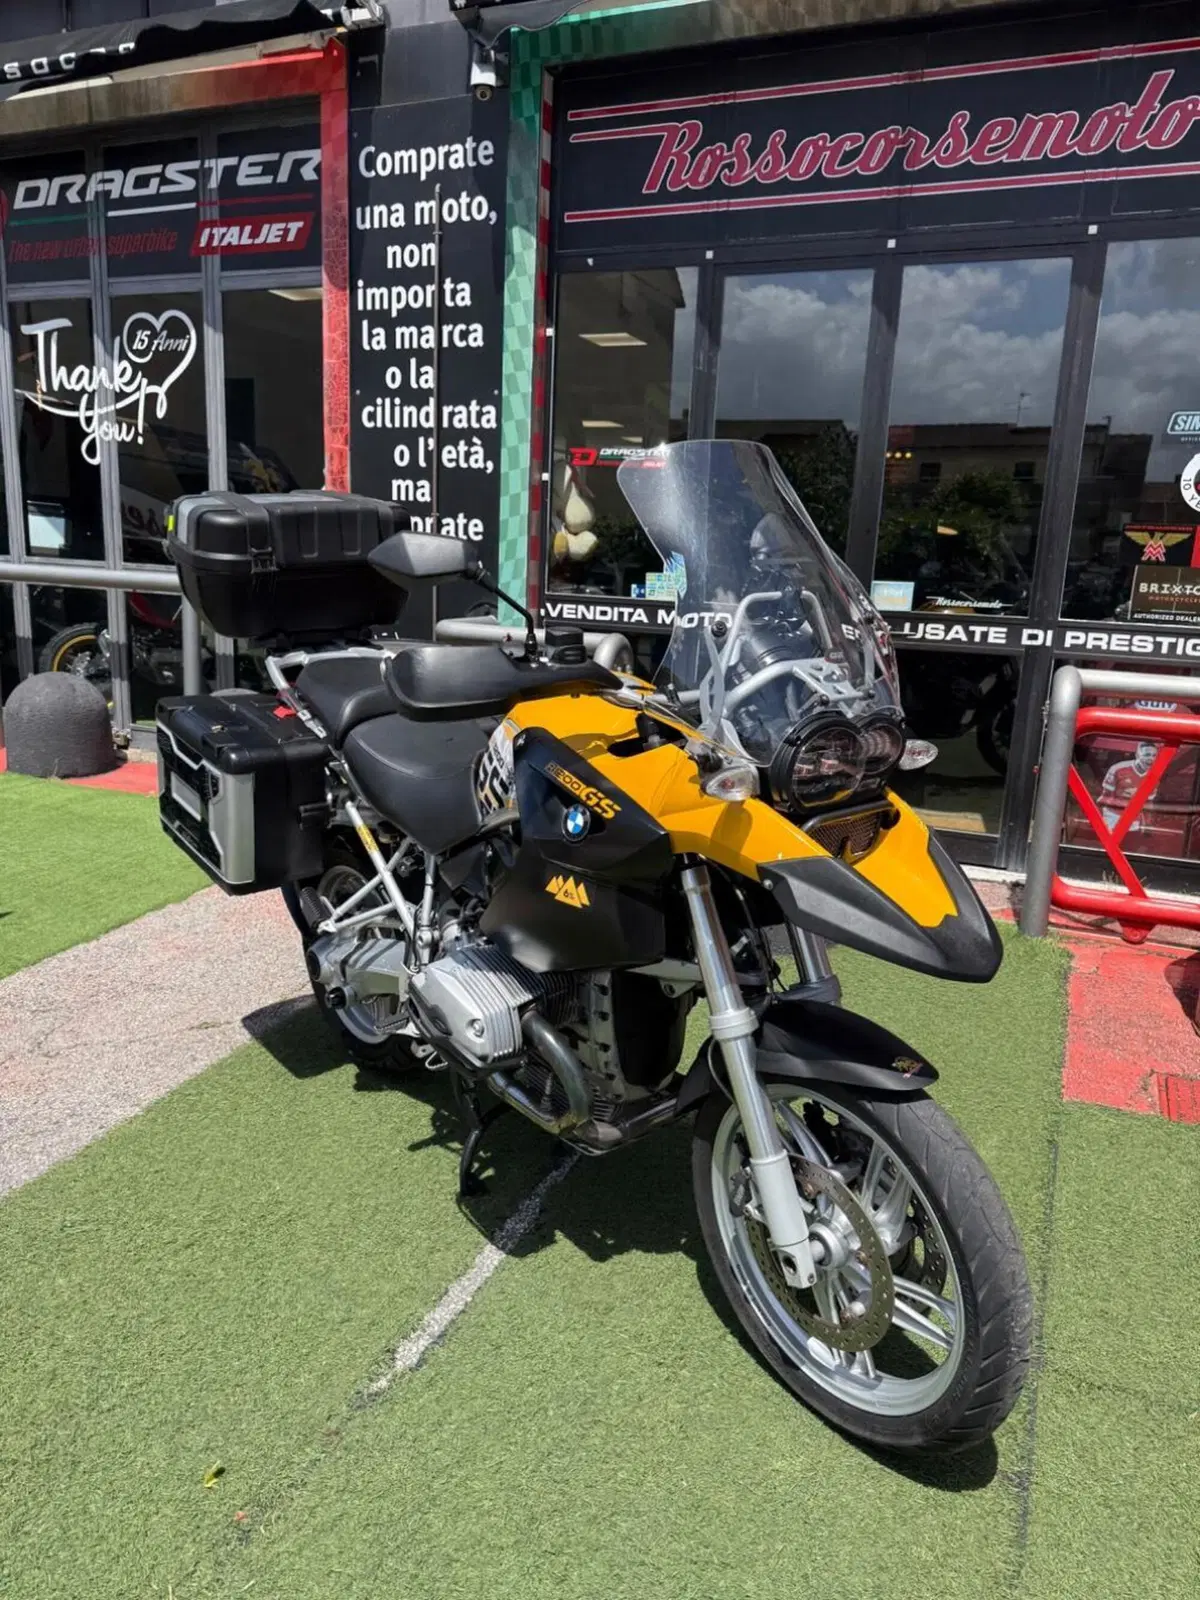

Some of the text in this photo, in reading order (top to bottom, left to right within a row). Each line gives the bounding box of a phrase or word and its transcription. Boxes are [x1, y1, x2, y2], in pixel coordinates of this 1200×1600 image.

[642, 68, 1200, 195] Rossocorsemoto
[358, 136, 495, 182] Comprate
[13, 149, 321, 210] DRAGSTER
[356, 190, 498, 230] una moto,
[199, 220, 305, 248] ITALJET
[386, 242, 437, 269] non
[357, 276, 472, 318] importa
[132, 329, 190, 353] 15 Anni
[361, 319, 485, 351] la marca
[21, 318, 143, 393] Thank
[385, 357, 436, 390] o la
[361, 397, 498, 430] cilindrata
[394, 444, 410, 468] o
[391, 478, 432, 502] ma
[546, 602, 649, 624] VENDITA
[903, 621, 1006, 645] USATE
[1021, 628, 1053, 647] DI
[1064, 631, 1200, 656] PRESTIG
